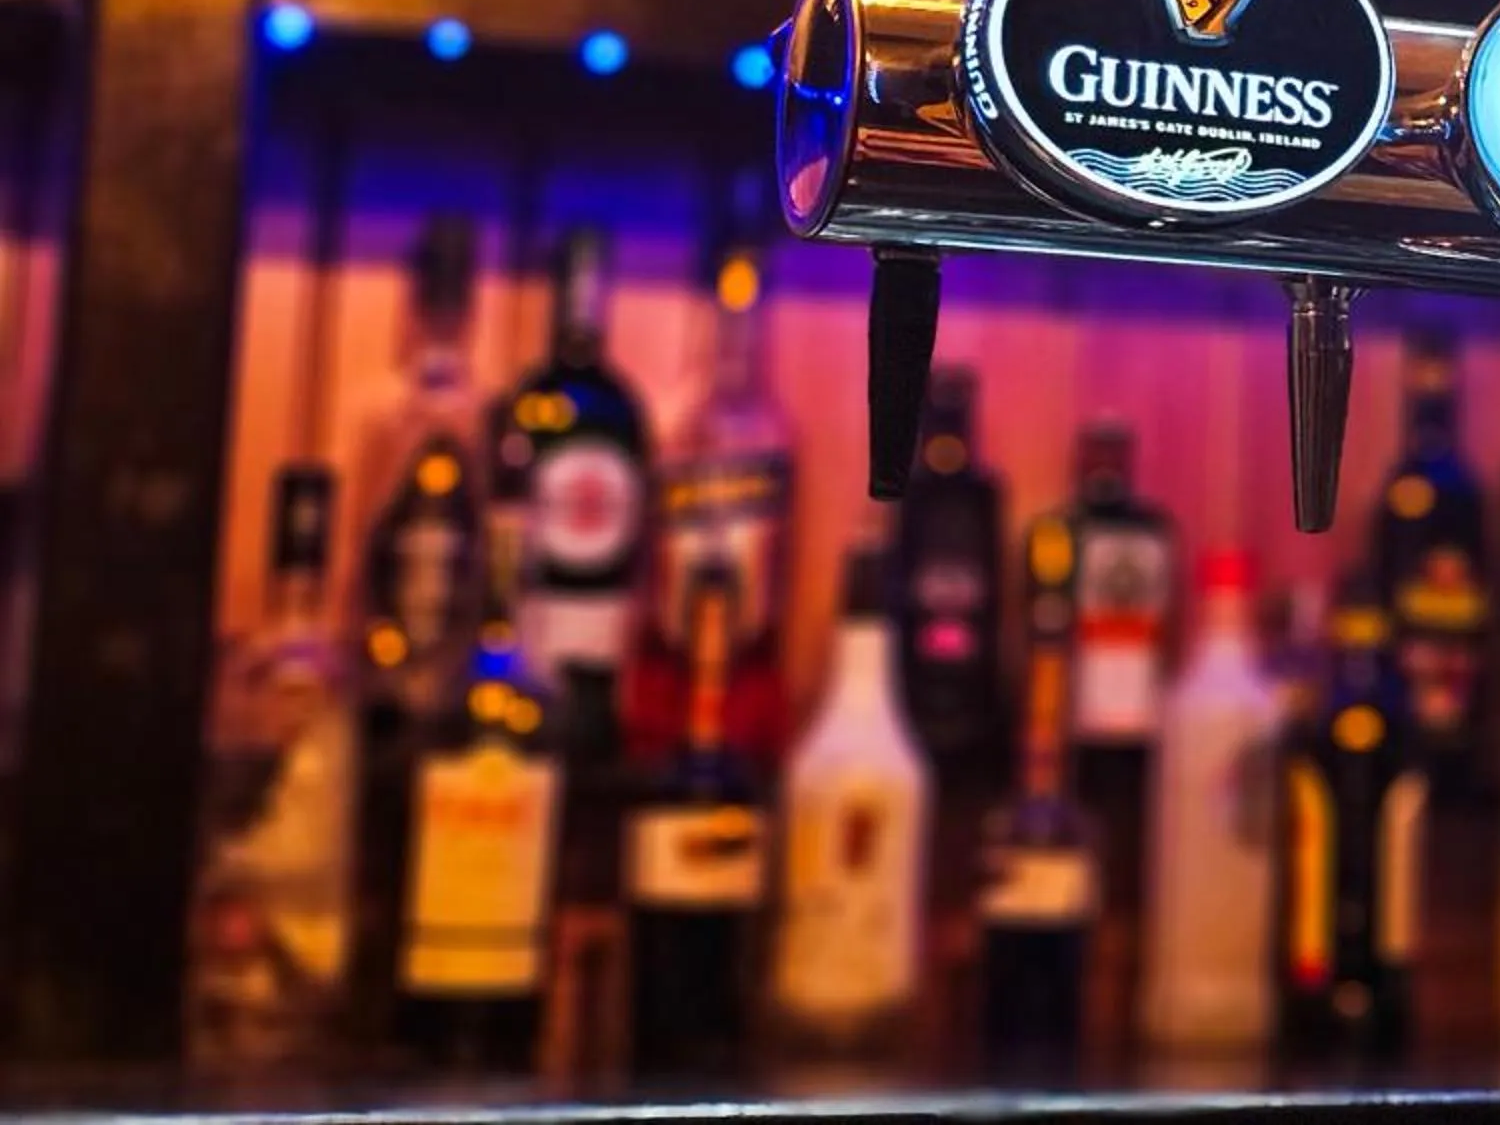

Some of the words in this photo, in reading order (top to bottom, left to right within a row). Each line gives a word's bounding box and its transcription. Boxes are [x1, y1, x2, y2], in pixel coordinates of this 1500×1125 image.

[1049, 45, 1338, 128] GUINNESS
[1155, 121, 1193, 135] GATE
[1259, 132, 1322, 150] IRELAND
